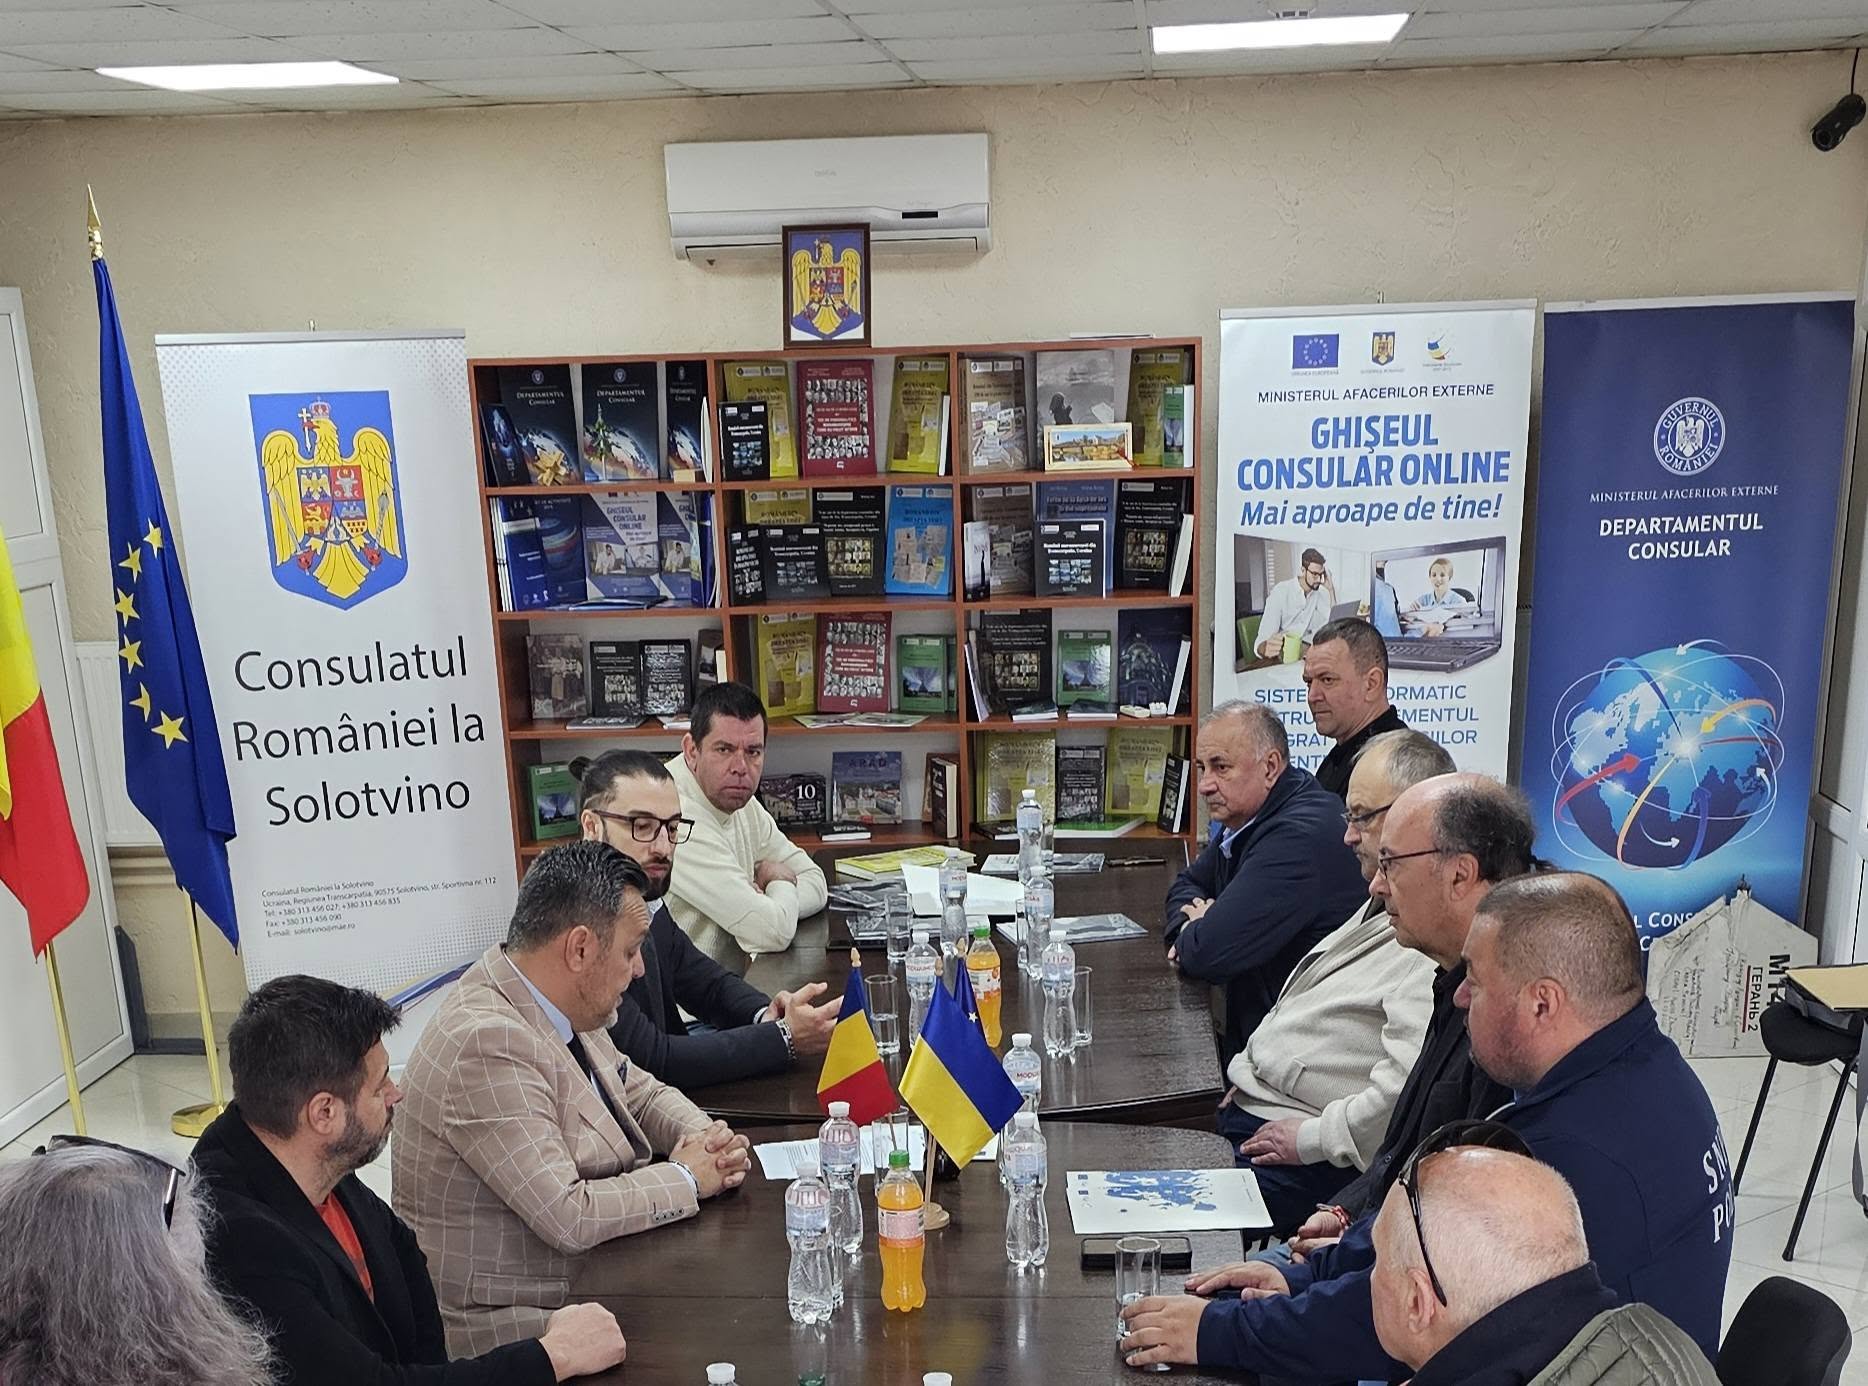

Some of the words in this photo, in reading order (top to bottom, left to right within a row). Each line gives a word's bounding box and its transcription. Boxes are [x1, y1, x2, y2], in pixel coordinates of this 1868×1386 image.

[1258, 388, 1339, 403] MINISTERUL
[1343, 386, 1428, 401] AFACERILOR
[1432, 384, 1495, 397] EXTERNE
[1662, 402, 1718, 430] GUVERNUL
[1659, 442, 1718, 472] ROMÂNIEI
[1237, 455, 1394, 491] CONSULAR
[1400, 451, 1511, 487] ONLINE
[1590, 490, 1658, 503] MINISTERUL
[1661, 487, 1728, 501] AFACERILOR
[1731, 484, 1779, 498] EXTERNE
[1240, 500, 1288, 526] Mai
[1292, 500, 1401, 528] aproape
[1403, 496, 1440, 521] de
[1442, 493, 1503, 520] tine!
[1599, 513, 1763, 537] DEPARTAMENTUL
[1628, 538, 1731, 560] CONSULAR
[234, 635, 467, 692] Consulatul
[1254, 688, 1306, 704] SISTE
[232, 706, 438, 761] României
[451, 703, 485, 743] la
[848, 758, 887, 768] ARAD
[266, 775, 470, 826] Solotvino
[796, 784, 816, 800] 10
[261, 886, 299, 898] Consulatul
[300, 884, 334, 894] României
[342, 881, 374, 890] Solotvino
[485, 876, 496, 885] 112
[1748, 966, 1763, 1020] ГЕРАНЬ
[1747, 1024, 1758, 1032] 2
